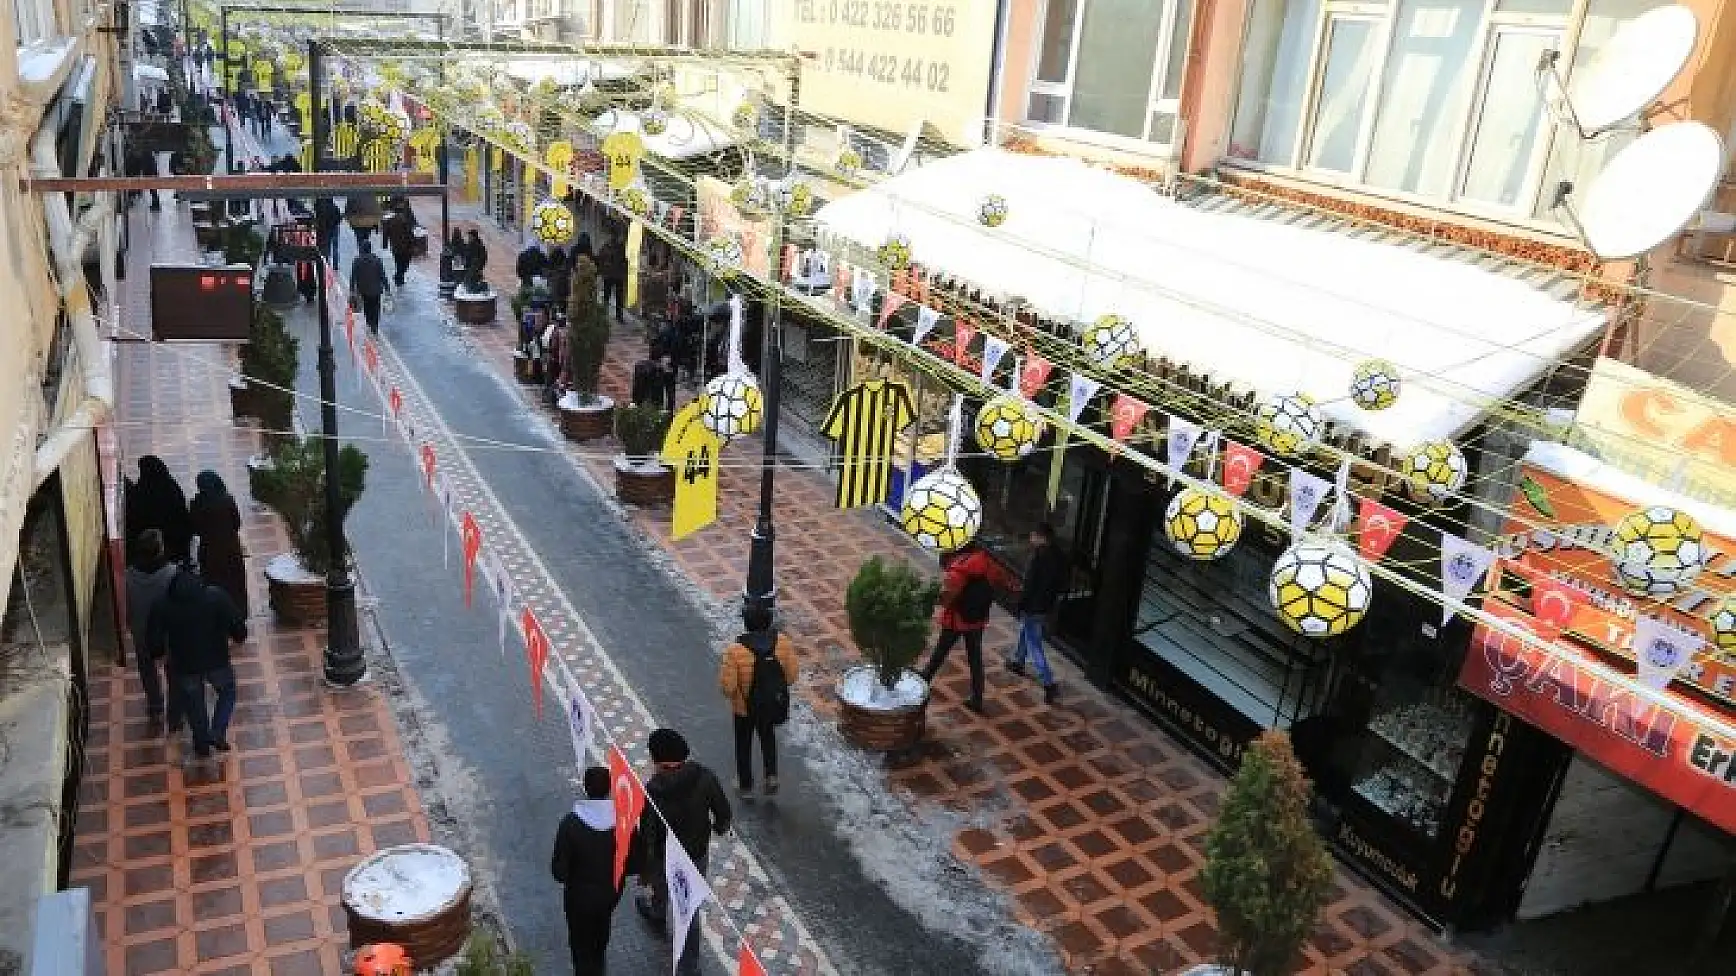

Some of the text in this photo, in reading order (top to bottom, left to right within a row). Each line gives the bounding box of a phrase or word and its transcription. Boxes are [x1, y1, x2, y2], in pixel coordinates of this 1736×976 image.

[842, 0, 868, 28] 422
[906, 4, 928, 35] 56
[932, 5, 955, 37] 66
[868, 52, 897, 84] 422
[901, 56, 923, 90] 44
[928, 60, 949, 93] 02
[685, 445, 710, 485] 44
